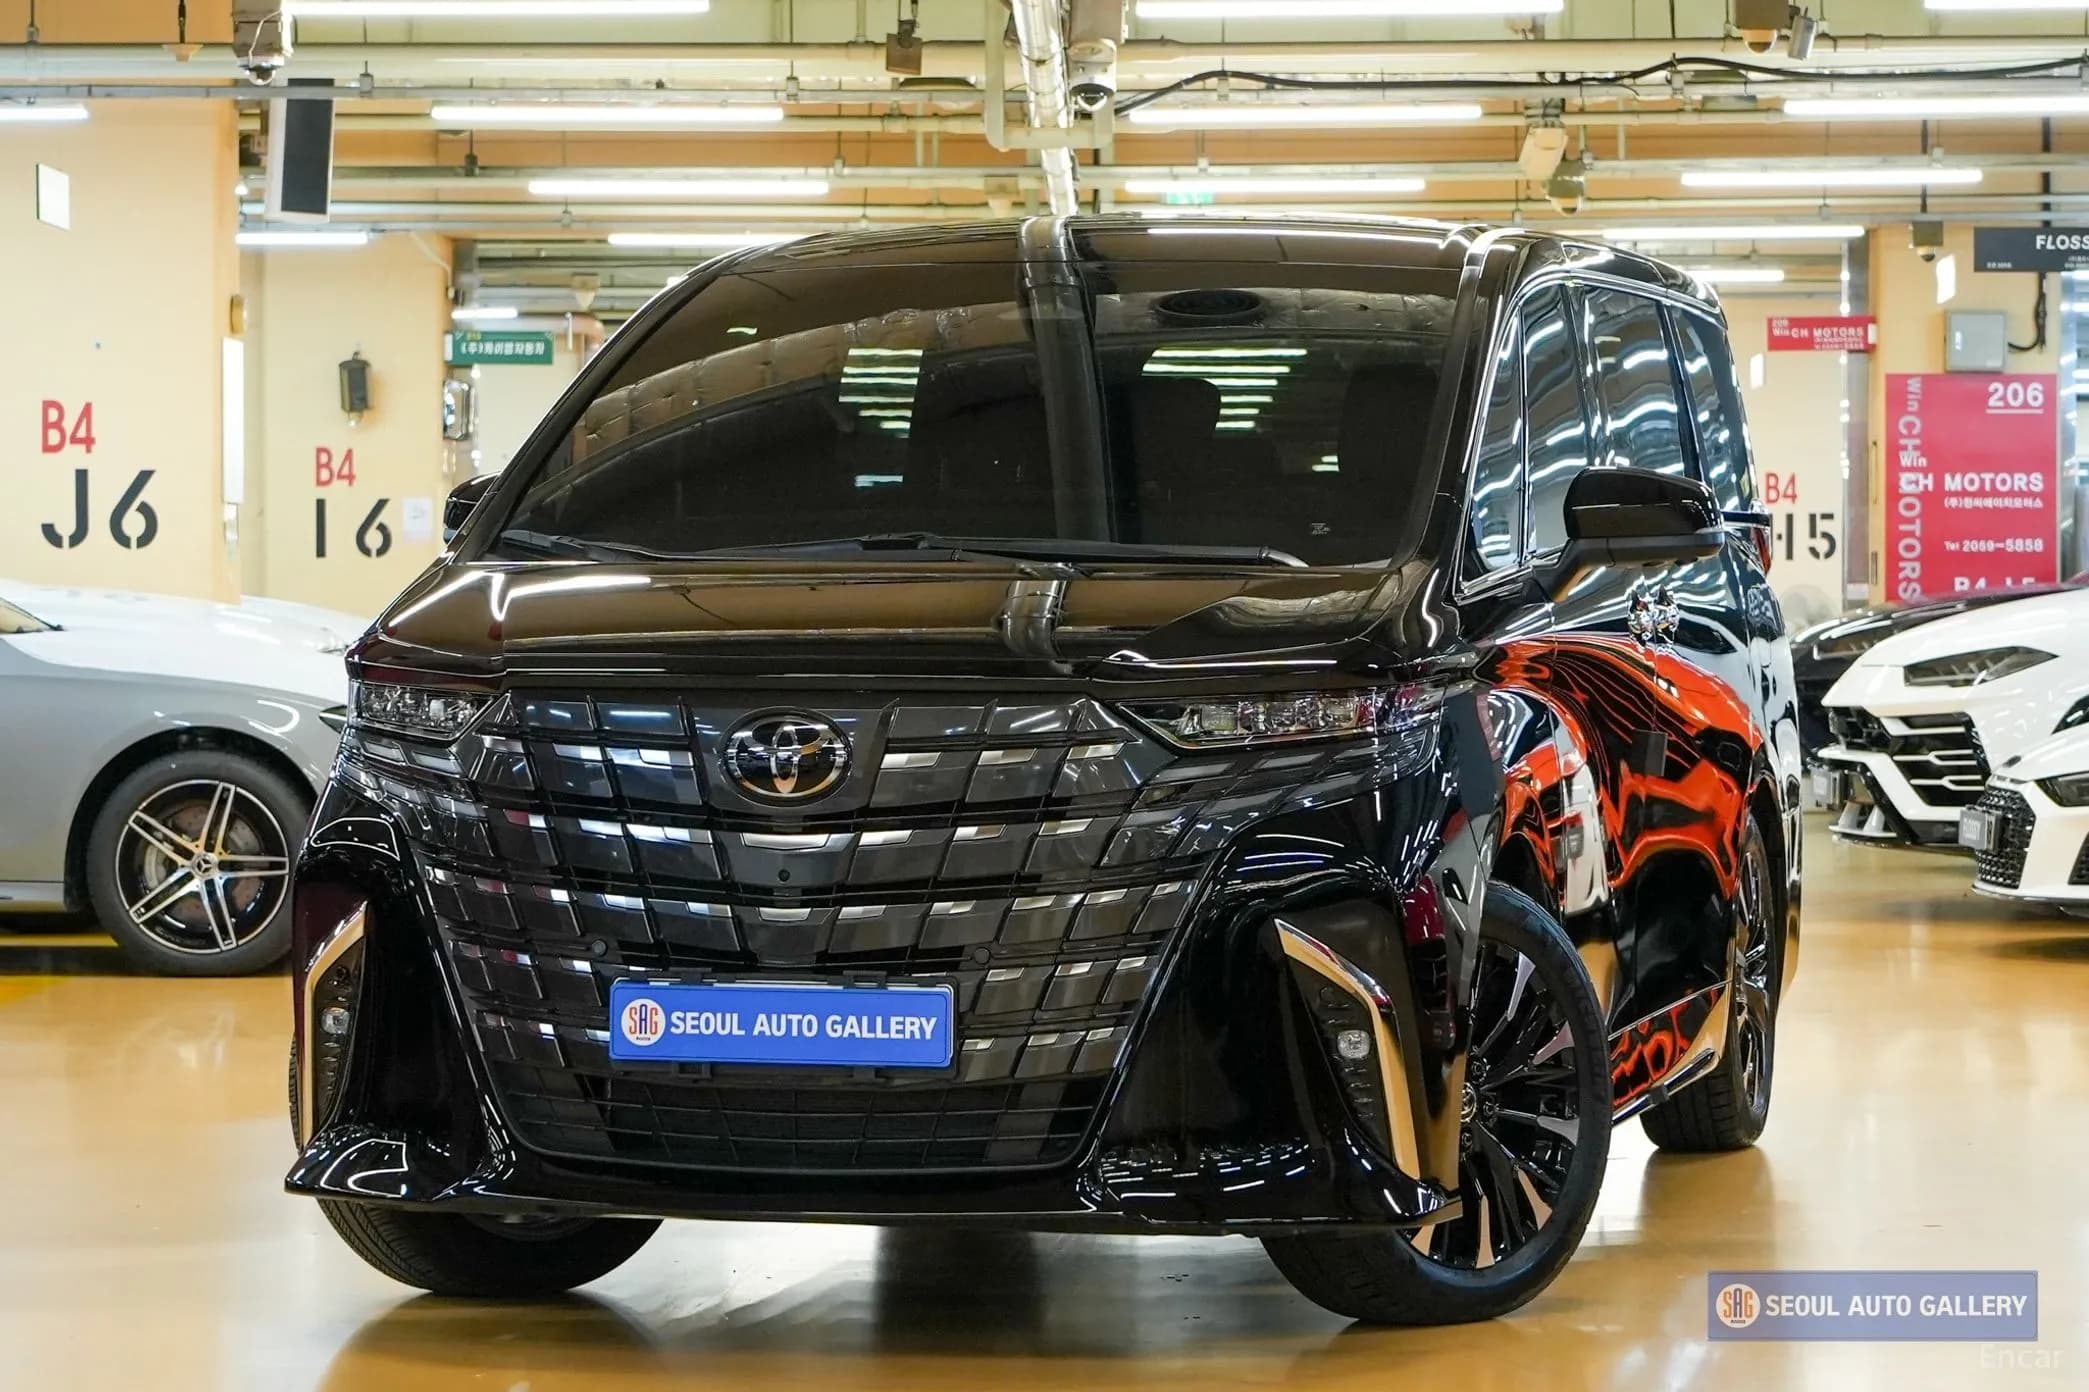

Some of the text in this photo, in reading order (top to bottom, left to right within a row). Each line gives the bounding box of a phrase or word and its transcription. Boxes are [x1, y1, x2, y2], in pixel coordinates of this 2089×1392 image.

[1791, 328, 1809, 338] CH
[1812, 327, 1865, 337] MOTORS
[1987, 382, 2044, 408] 206
[41, 400, 96, 454] B4
[314, 447, 357, 487] B4
[1900, 455, 1928, 467] Win
[1765, 472, 1797, 504] B4
[1943, 472, 2045, 492] MOTORS
[628, 1003, 938, 1040] SAG SEOUL AUTO GALLERY
